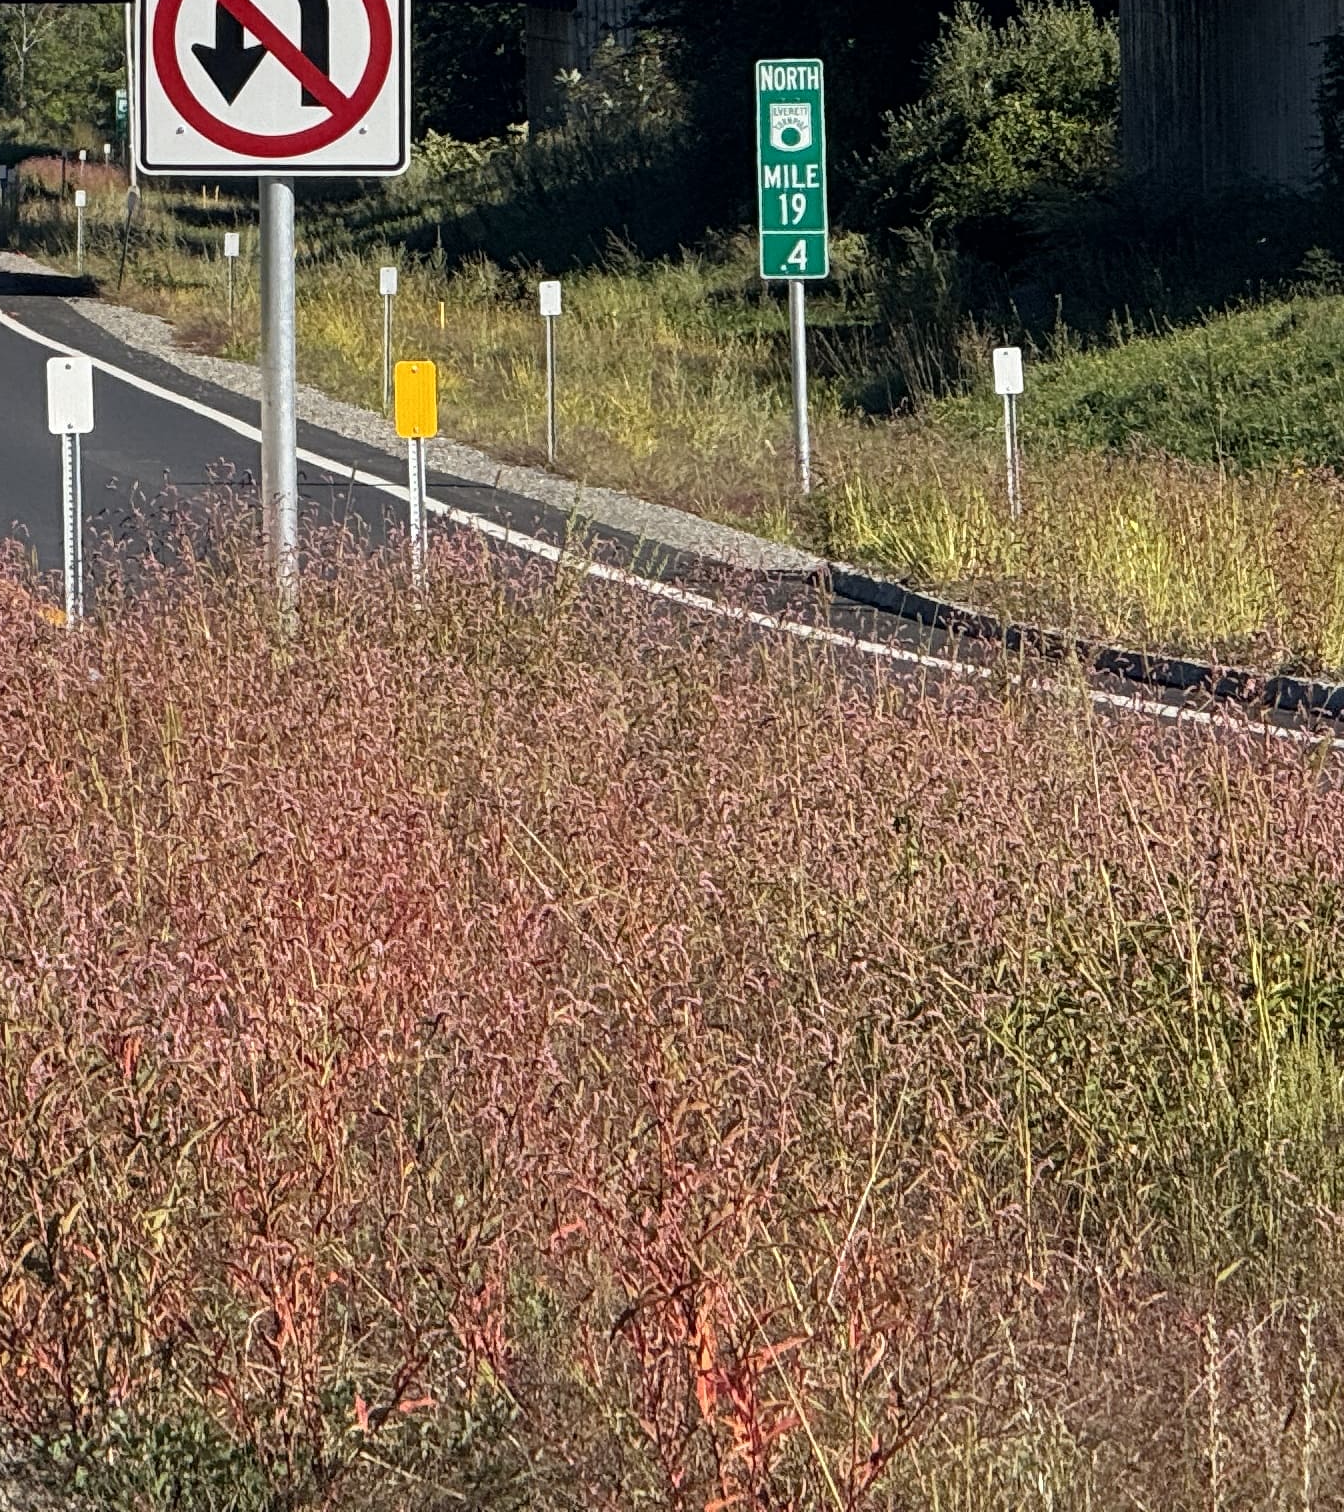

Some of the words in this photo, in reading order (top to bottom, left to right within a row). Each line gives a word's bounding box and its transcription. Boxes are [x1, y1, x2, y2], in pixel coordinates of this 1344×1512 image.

[760, 65, 819, 91] NORTH
[763, 164, 820, 189] MILE
[778, 193, 807, 226] 19
[780, 239, 807, 271] .4
